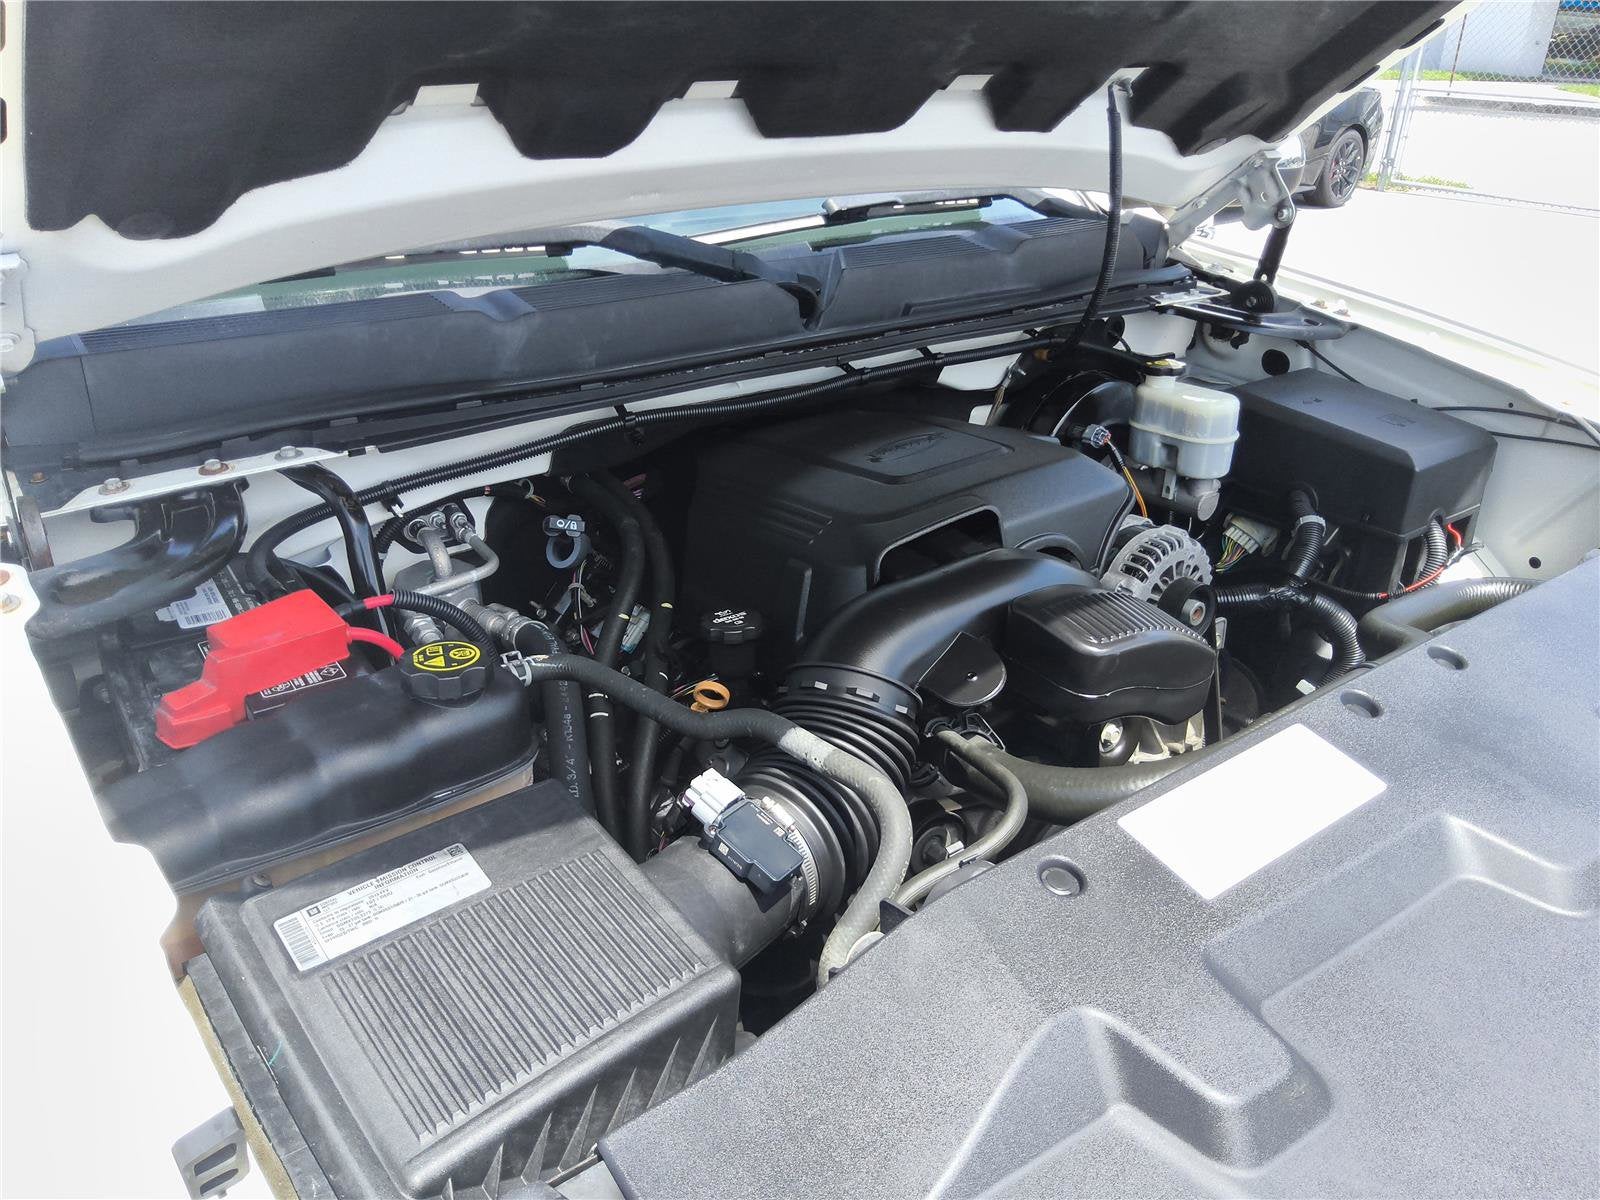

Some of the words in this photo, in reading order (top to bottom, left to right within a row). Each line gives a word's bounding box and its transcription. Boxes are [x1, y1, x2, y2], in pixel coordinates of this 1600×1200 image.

[347, 881, 374, 896] VEHICLE
[376, 866, 407, 884] EMISSION
[408, 855, 437, 870] CONTROL
[374, 867, 419, 890] INFORMATION
